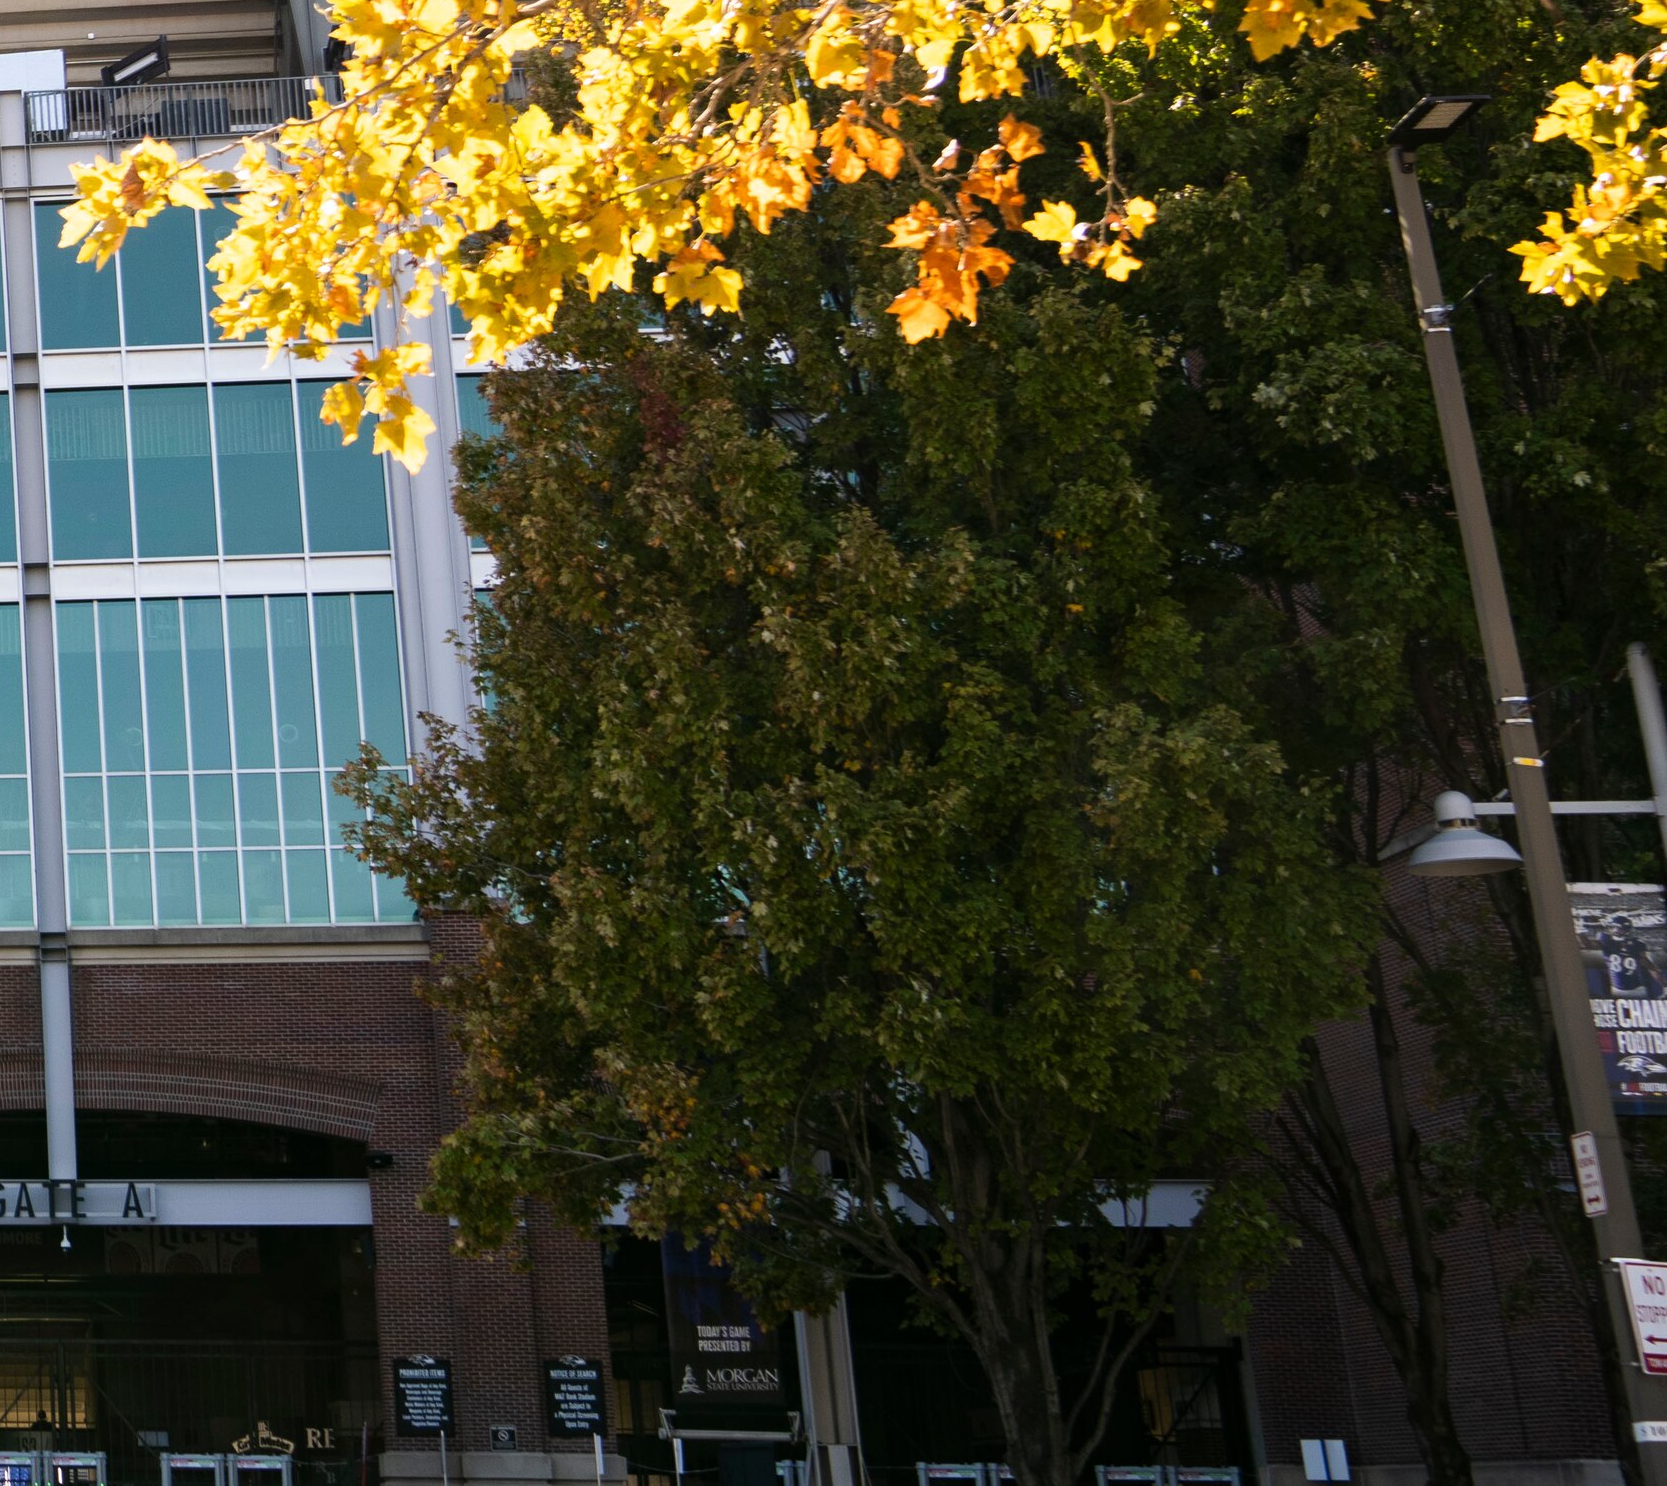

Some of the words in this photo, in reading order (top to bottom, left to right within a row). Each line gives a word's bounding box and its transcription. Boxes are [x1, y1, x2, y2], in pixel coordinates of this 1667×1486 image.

[1609, 954, 1637, 975] 89
[122, 1181, 144, 1218] A
[1641, 1275, 1666, 1296] NO
[697, 1325, 727, 1338] TODAY'S
[729, 1326, 751, 1338] GAME
[698, 1339, 740, 1352] PRESENTED
[741, 1340, 752, 1352] BY
[707, 1368, 779, 1383] MORGAN
[707, 1382, 730, 1391] STATE
[731, 1382, 779, 1391] UNIVERSITY
